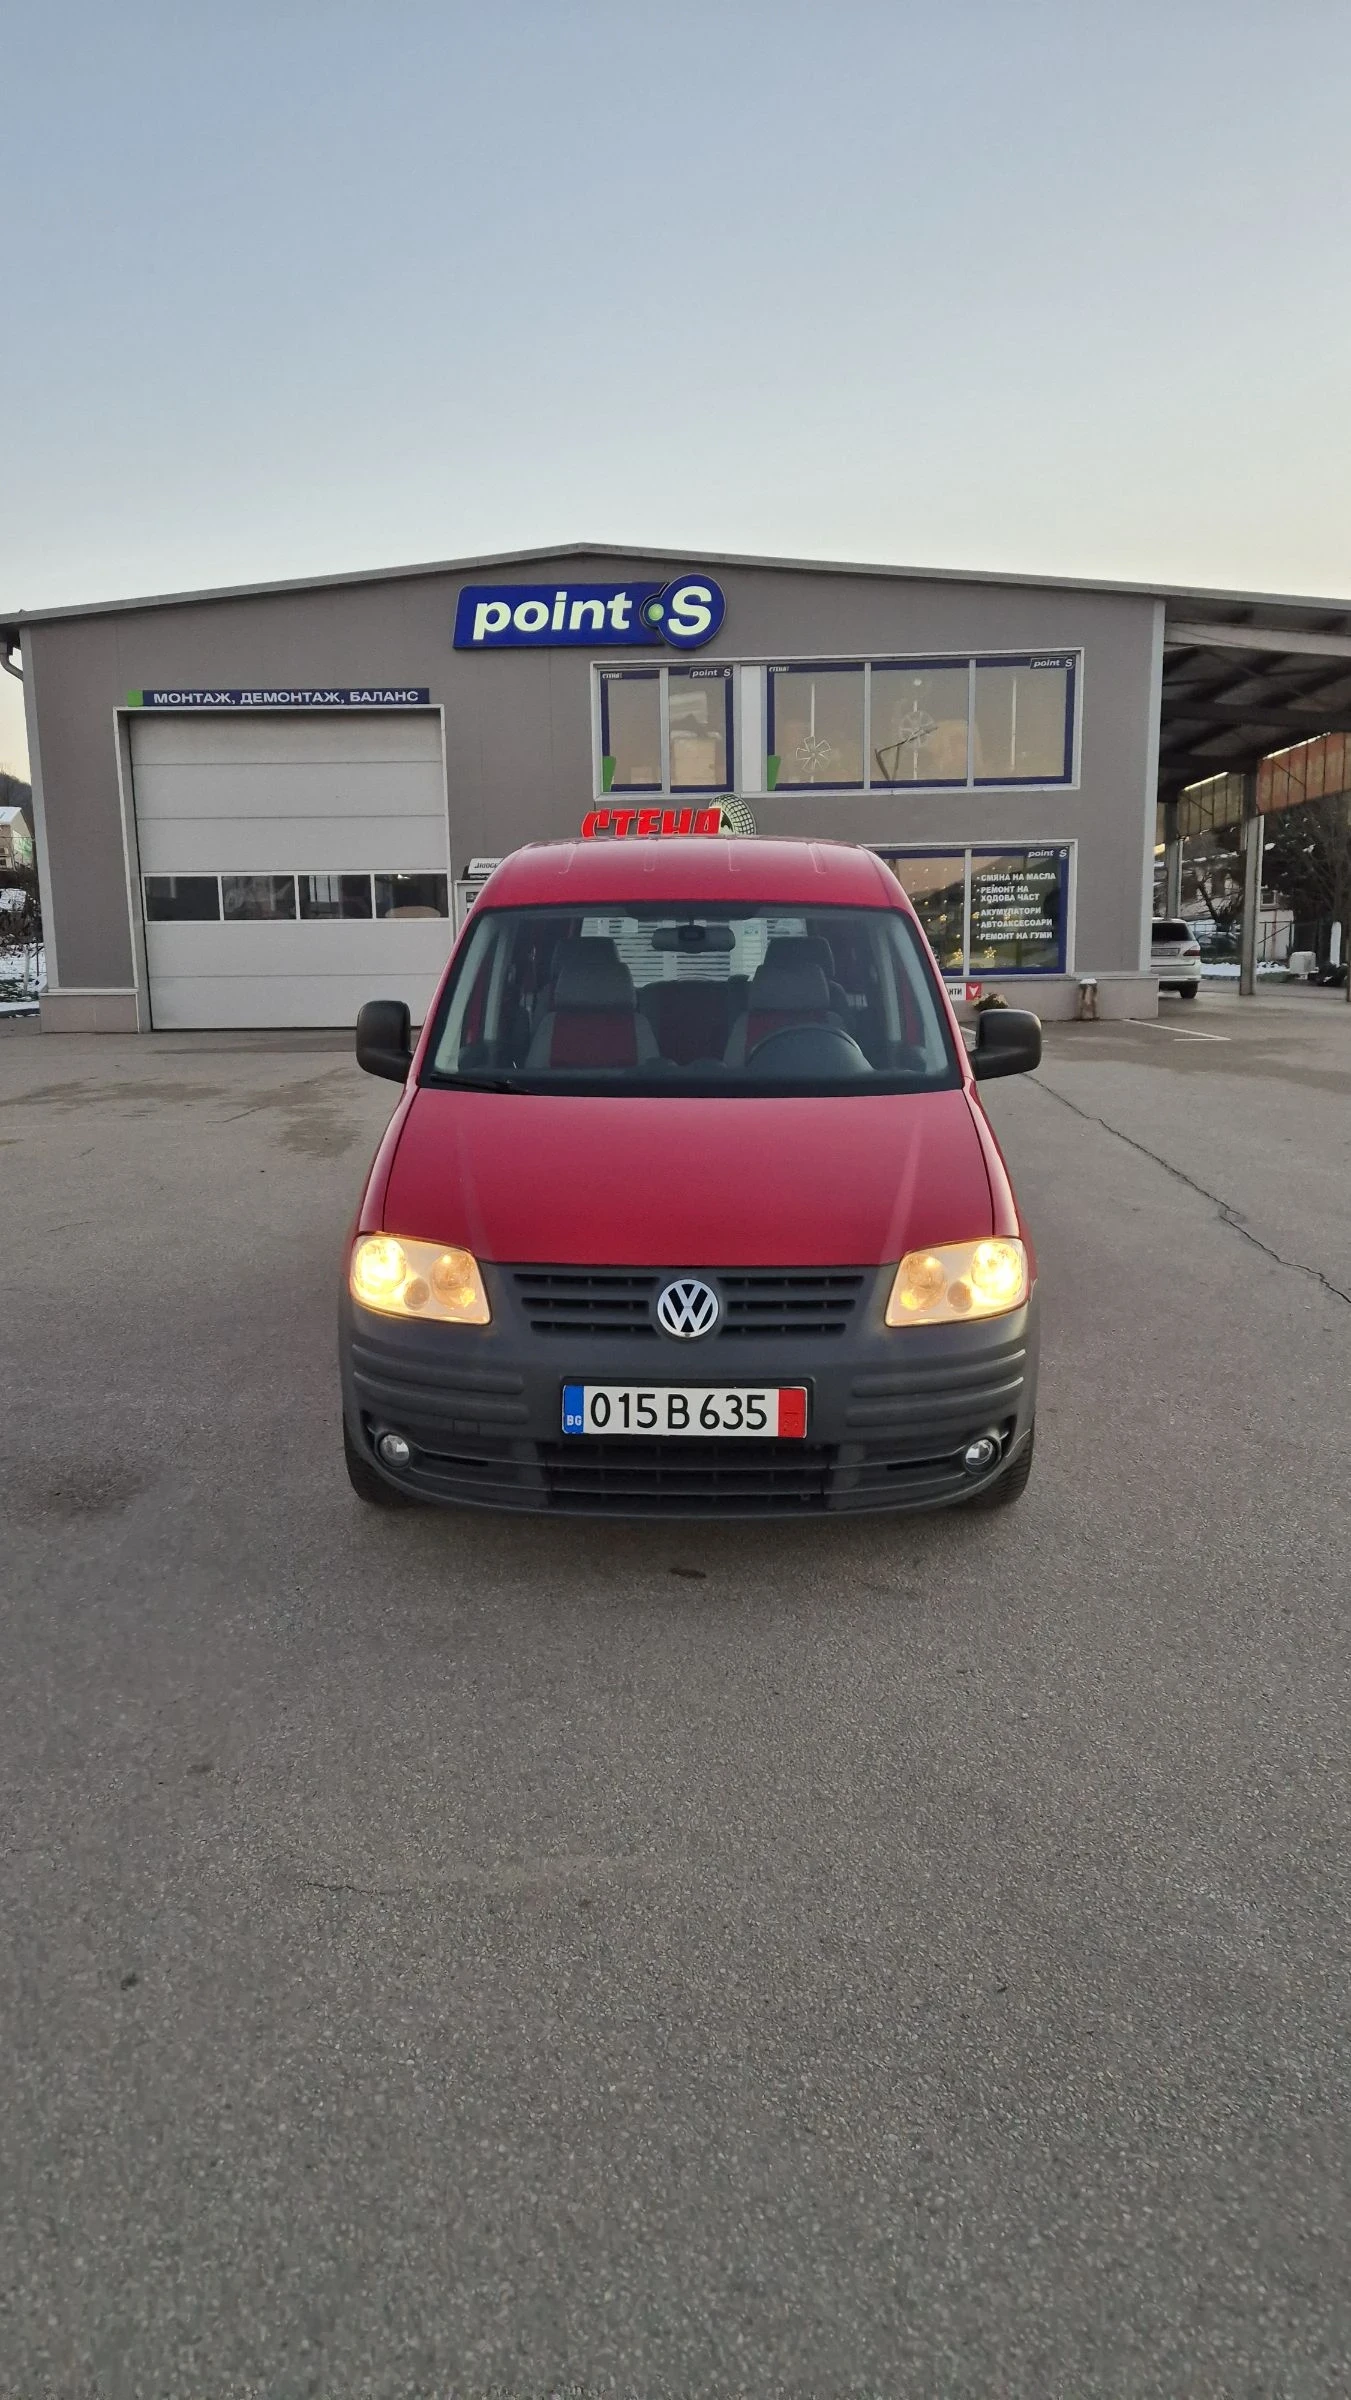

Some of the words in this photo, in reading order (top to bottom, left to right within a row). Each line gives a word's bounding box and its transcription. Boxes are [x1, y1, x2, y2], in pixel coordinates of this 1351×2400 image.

[473, 590, 632, 641] point
[667, 586, 713, 637] S
[1034, 659, 1060, 668] point
[1065, 658, 1073, 667] S
[692, 668, 718, 678] point
[723, 667, 731, 677] S
[153, 690, 236, 705] МОНТАЖ,
[240, 690, 345, 705] ДЕМОНТАЖ,
[349, 690, 419, 704] БАЛАНС
[1028, 849, 1054, 858] point
[1058, 848, 1068, 858] S
[981, 873, 1011, 881] СМЯНА
[1026, 872, 1056, 880] МАСЛА
[980, 886, 1015, 894] РЕМОНТ
[1017, 885, 1029, 893] НА
[981, 894, 1015, 903] ХОДОВА
[1018, 893, 1040, 902] ЧАСТ
[981, 907, 1042, 916] АКУМУЛАТОРИ
[981, 919, 1053, 928] АВТОАКСЕСОАРИ
[980, 932, 1014, 940] РЕМОНТ
[1016, 932, 1028, 940] НА
[1030, 931, 1053, 939] ГУМИ
[566, 1415, 582, 1427] BG
